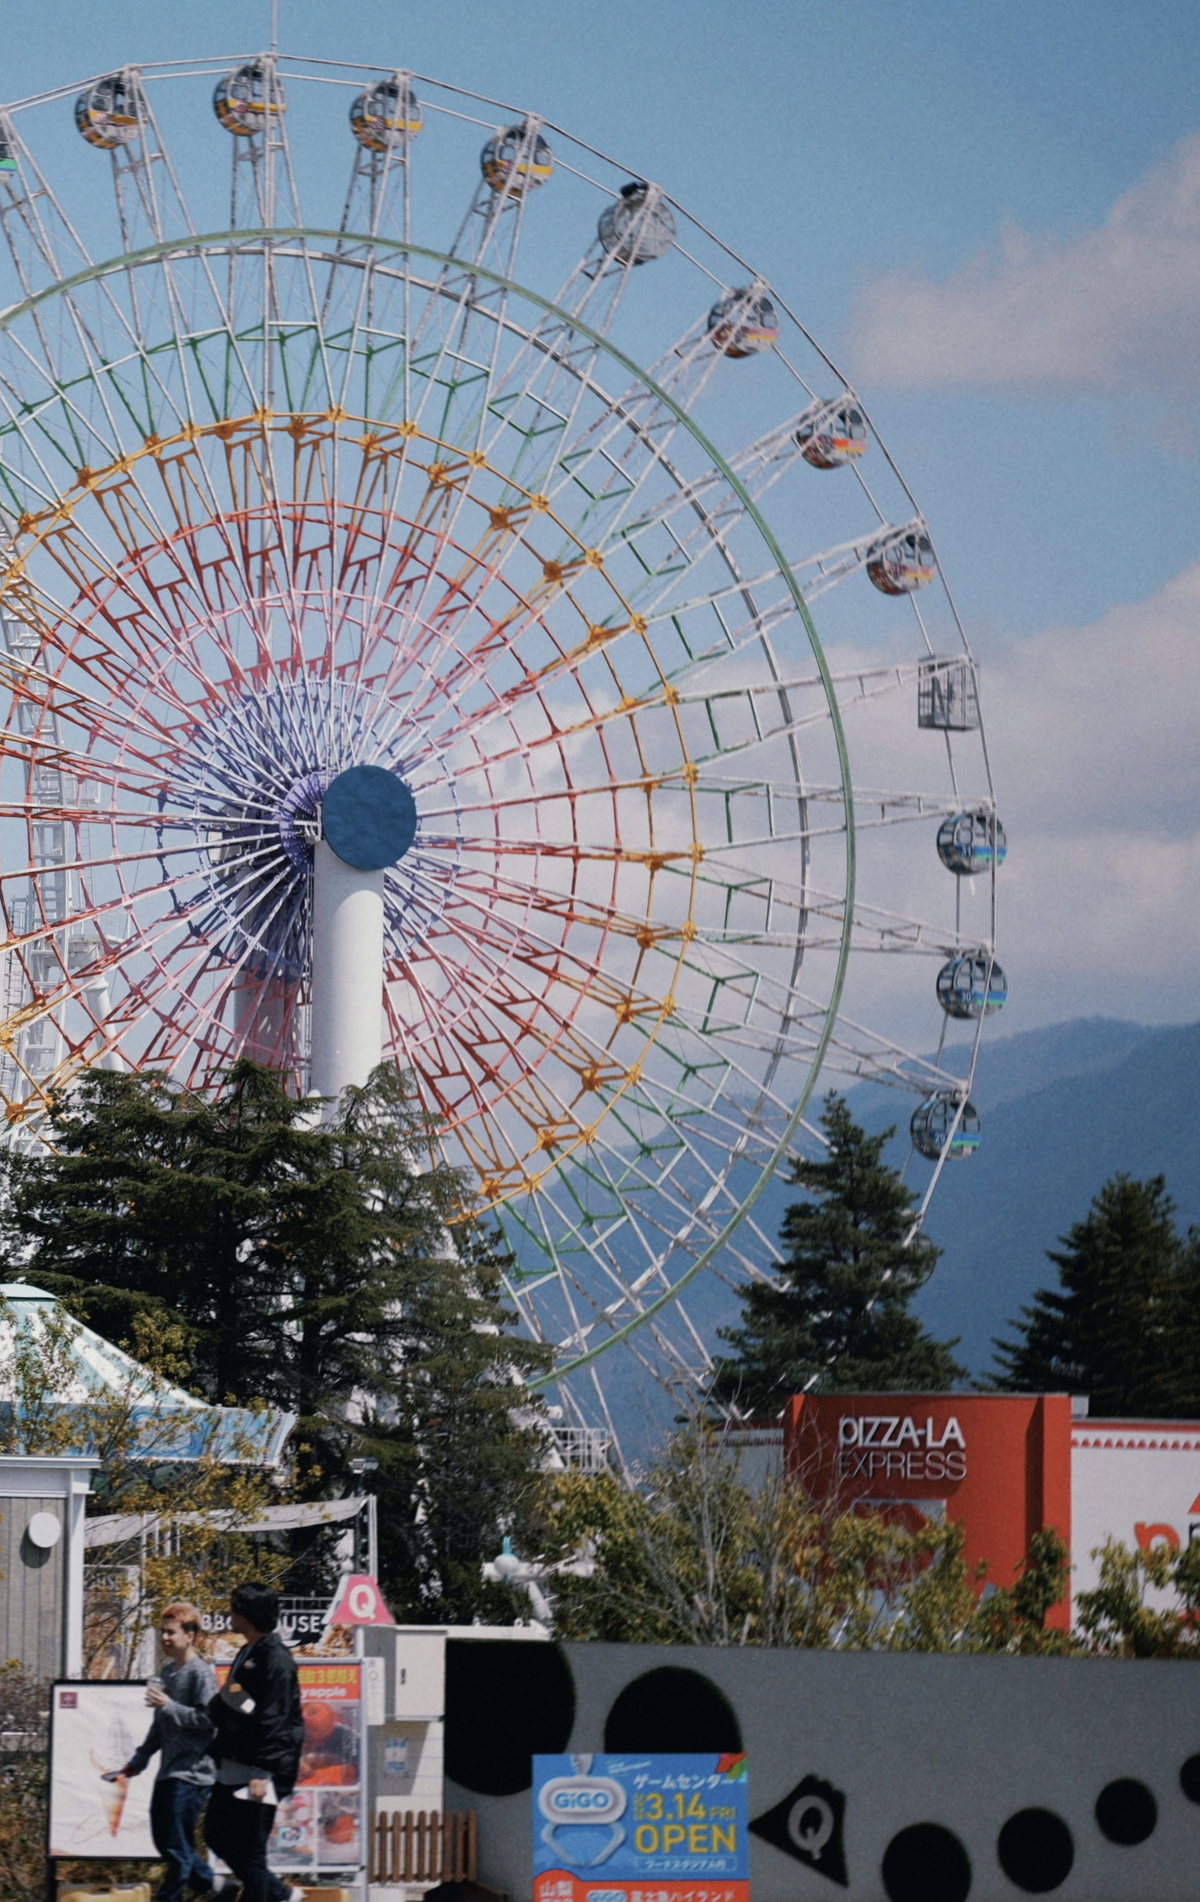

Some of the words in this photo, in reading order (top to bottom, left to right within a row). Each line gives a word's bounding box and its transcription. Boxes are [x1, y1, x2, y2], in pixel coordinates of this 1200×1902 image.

[839, 1416, 967, 1449] PIZZA-LA
[839, 1451, 968, 1481] EXPRESS
[349, 1584, 377, 1620] Q
[283, 1614, 322, 1634] USE
[300, 1686, 347, 1699] yapple
[633, 1774, 736, 1790] ゲームセンター
[647, 1793, 706, 1820] 3.14
[710, 1806, 737, 1819] FRI
[634, 1824, 736, 1854] OPEN
[788, 1795, 834, 1861] Q
